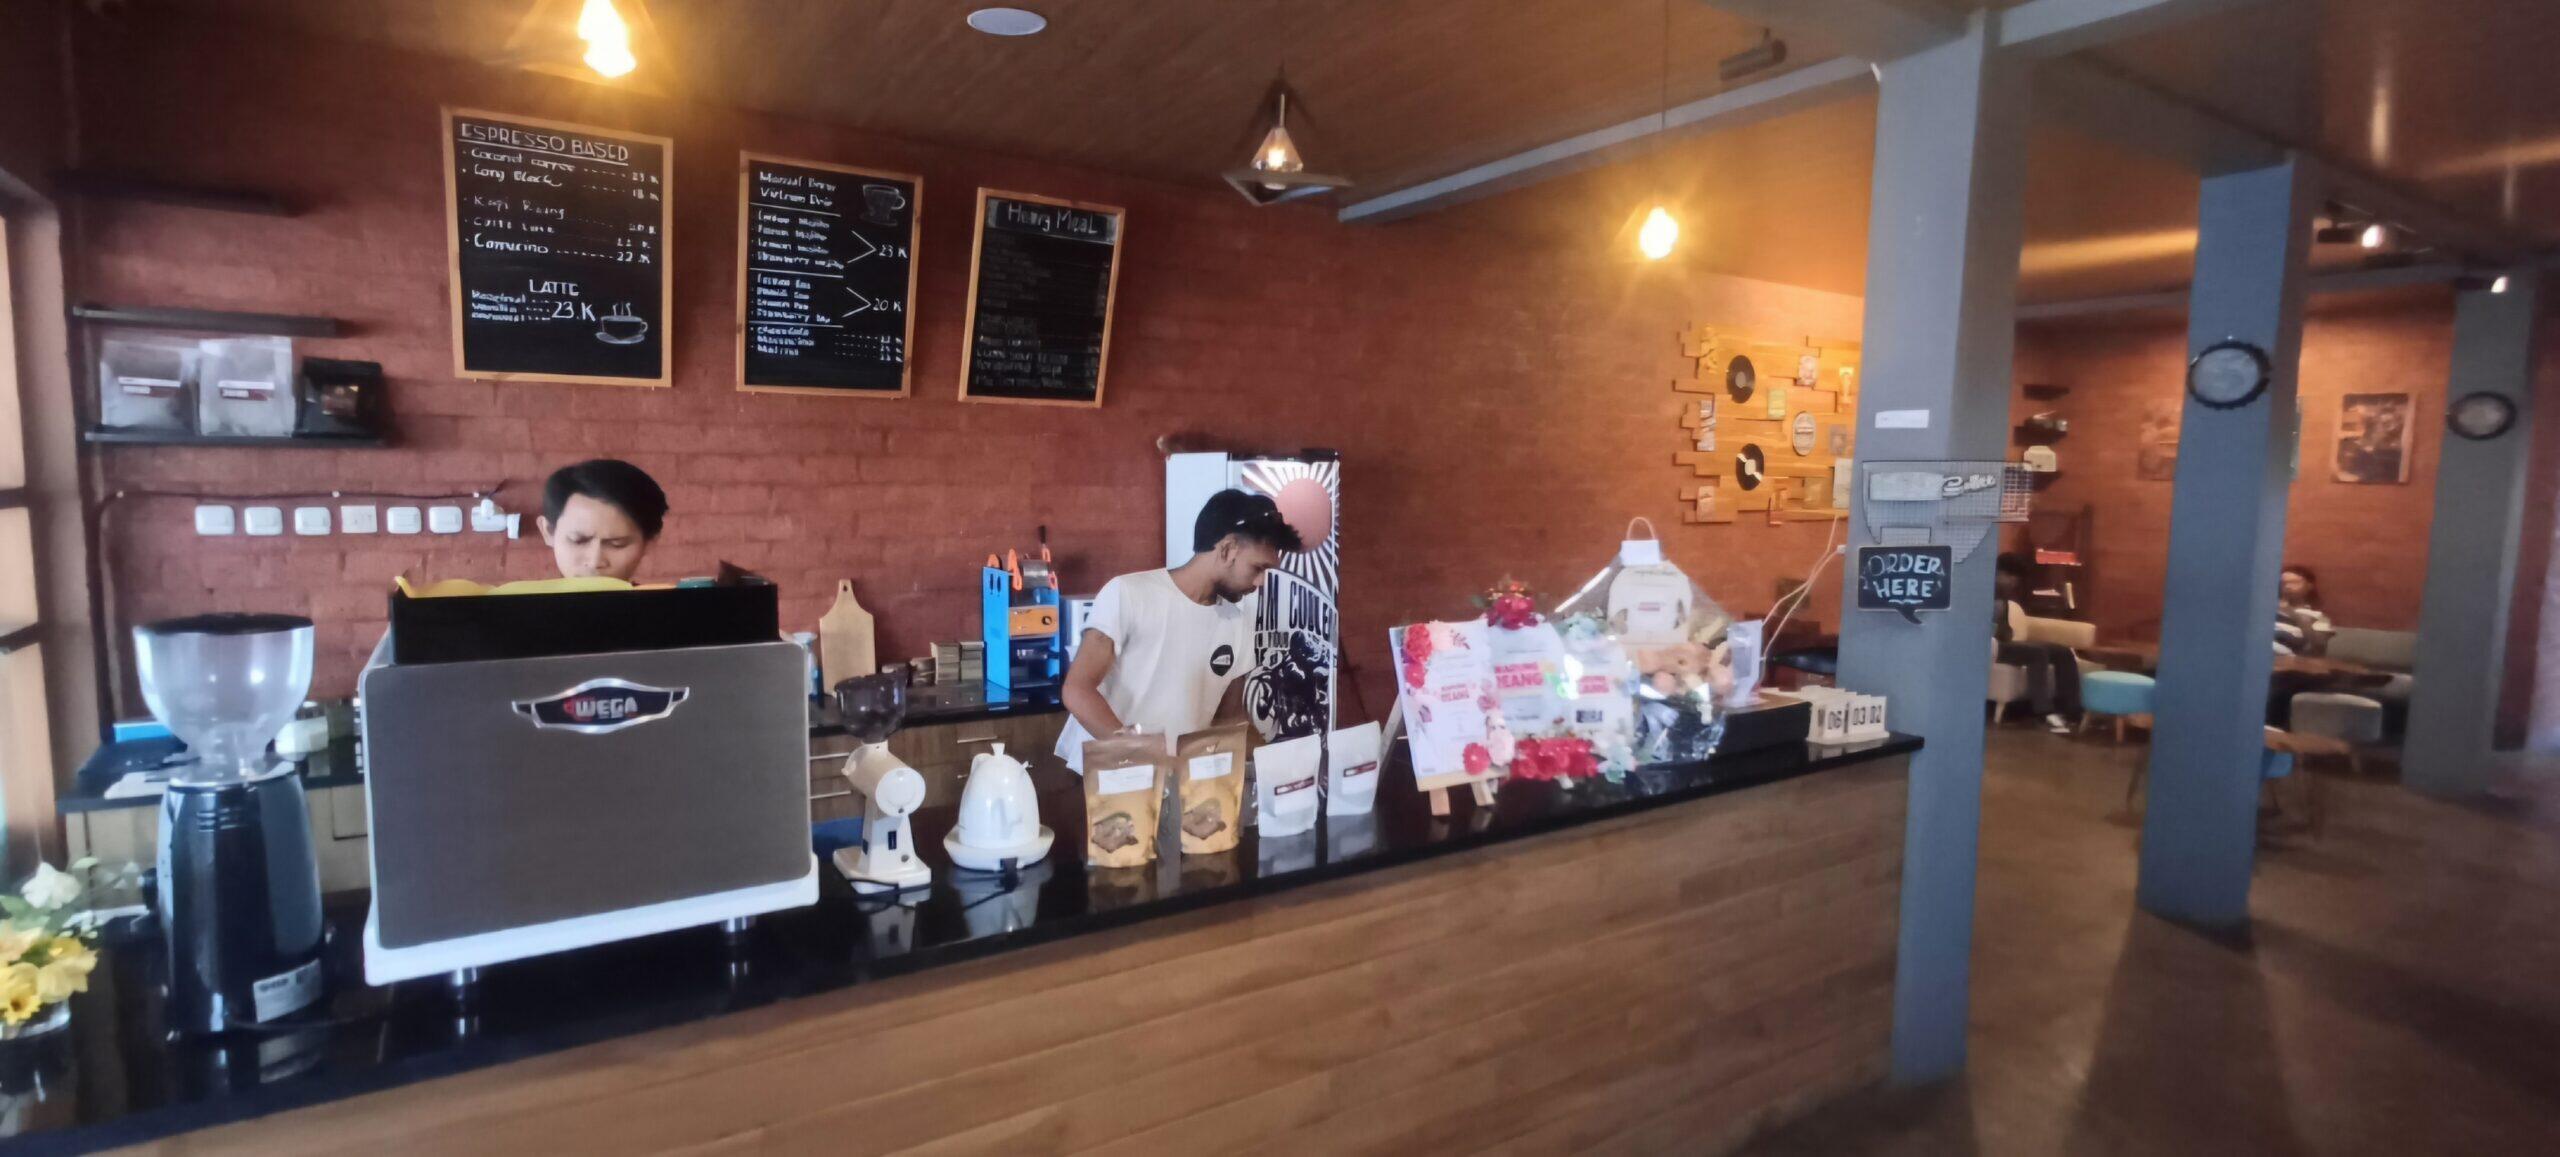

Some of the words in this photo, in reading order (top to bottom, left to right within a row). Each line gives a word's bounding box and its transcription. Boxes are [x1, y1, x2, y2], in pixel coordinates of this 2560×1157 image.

[461, 122, 565, 151] ESPRESSO
[571, 139, 629, 161] BASED
[474, 163, 505, 182] Long
[616, 251, 633, 262] 22
[878, 244, 894, 258] 23
[898, 246, 908, 259] K
[528, 278, 580, 296] LATTE
[872, 297, 889, 312] 20
[893, 300, 902, 312] K
[1868, 553, 1945, 577] ORDER
[1872, 577, 1935, 599] HERE
[575, 697, 638, 718] WEGA
